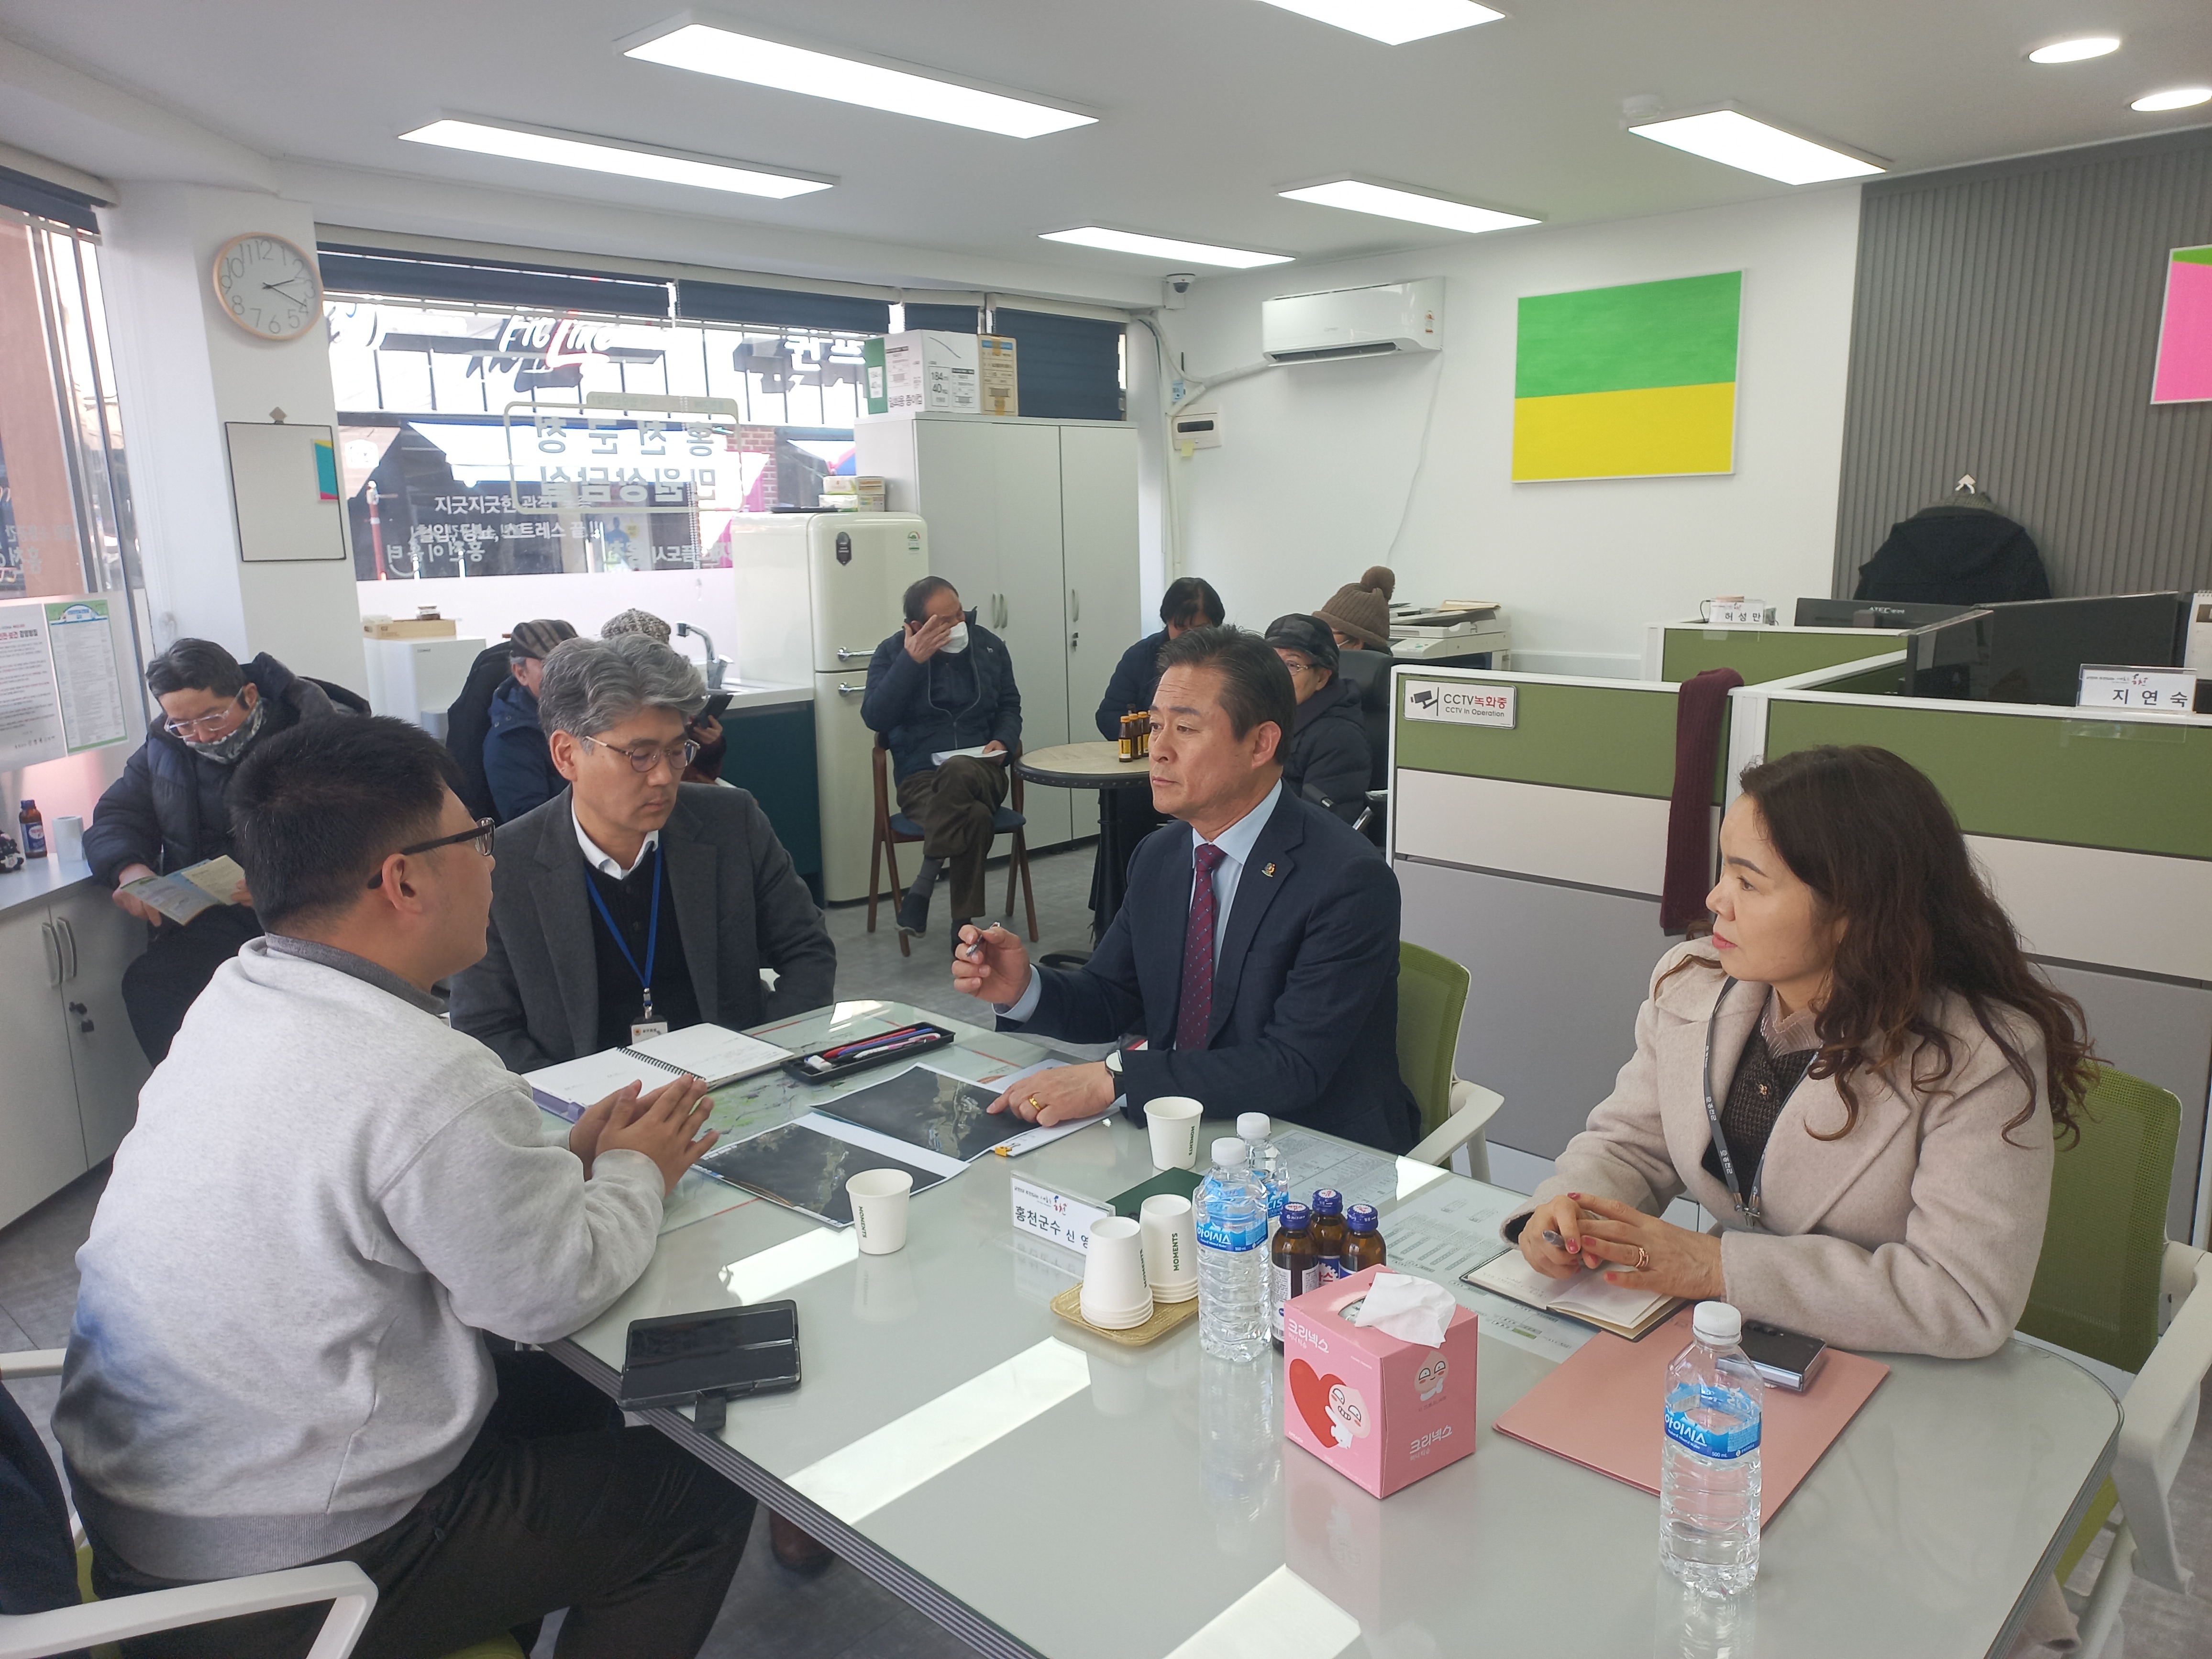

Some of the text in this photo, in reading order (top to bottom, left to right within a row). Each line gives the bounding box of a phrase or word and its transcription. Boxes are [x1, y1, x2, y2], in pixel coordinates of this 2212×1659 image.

[254, 240, 274, 260] 12
[292, 259, 305, 279] 2
[221, 275, 232, 295] 9
[303, 279, 316, 299] 3
[232, 295, 244, 315] 8
[250, 308, 262, 328] 7
[268, 314, 281, 334] 6
[288, 309, 300, 329] 5
[1471, 708, 1504, 718] Operation
[858, 1205, 867, 1239] MOMENTS
[1015, 1205, 1061, 1236] 홍천군수
[1066, 1229, 1075, 1243] 신
[1197, 1226, 1232, 1245] 아이시스
[1172, 1232, 1180, 1272] MOMENTS
[1139, 1248, 1148, 1289] MOMENTS
[1288, 1318, 1329, 1354] 크리넥스
[1409, 1425, 1452, 1454] 크리넥스
[1664, 1413, 1707, 1447] 아이시스
